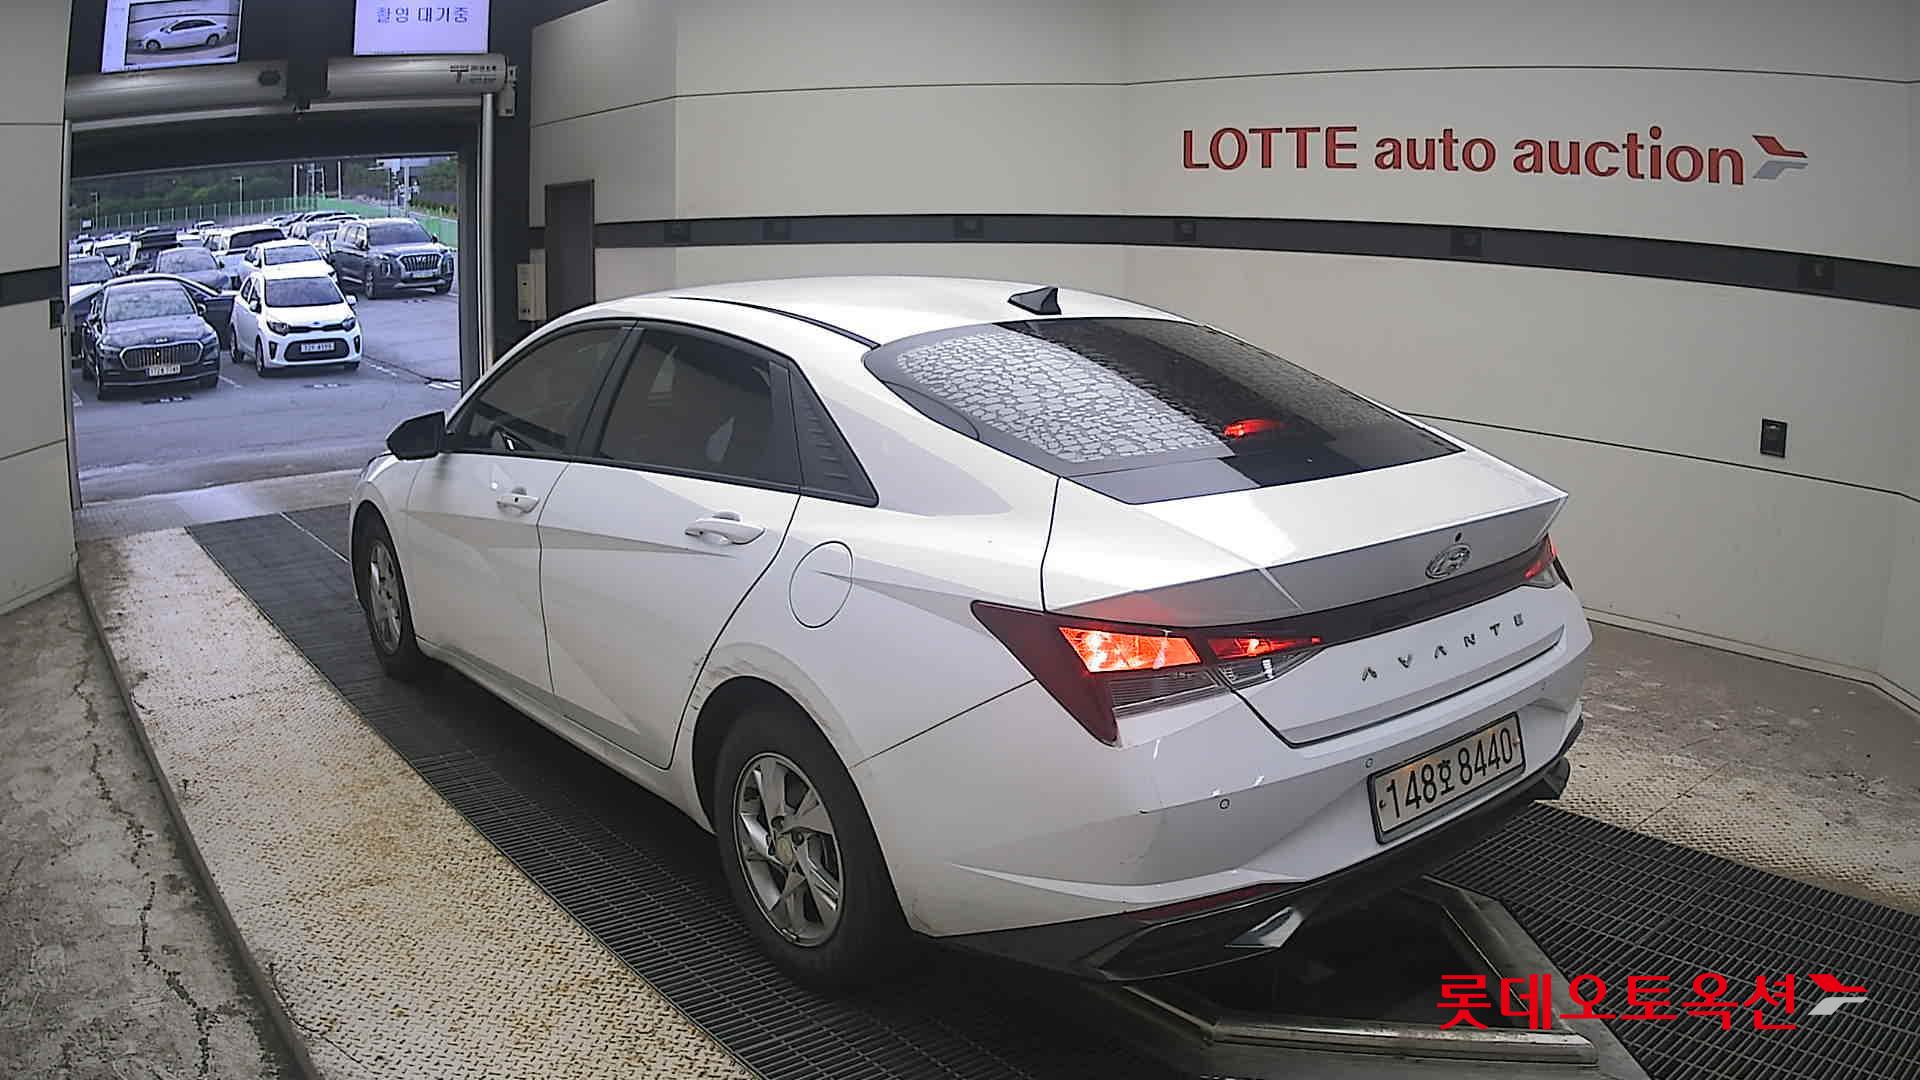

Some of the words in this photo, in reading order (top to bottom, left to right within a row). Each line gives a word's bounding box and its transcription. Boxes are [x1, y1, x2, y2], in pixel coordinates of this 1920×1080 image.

[417, 7, 469, 23] 대기중
[1183, 125, 1358, 170] LOTTE
[1374, 128, 1497, 172] auto
[1512, 125, 1744, 186] auction
[1361, 613, 1524, 681] AVANTE
[1457, 727, 1513, 786] 8440
